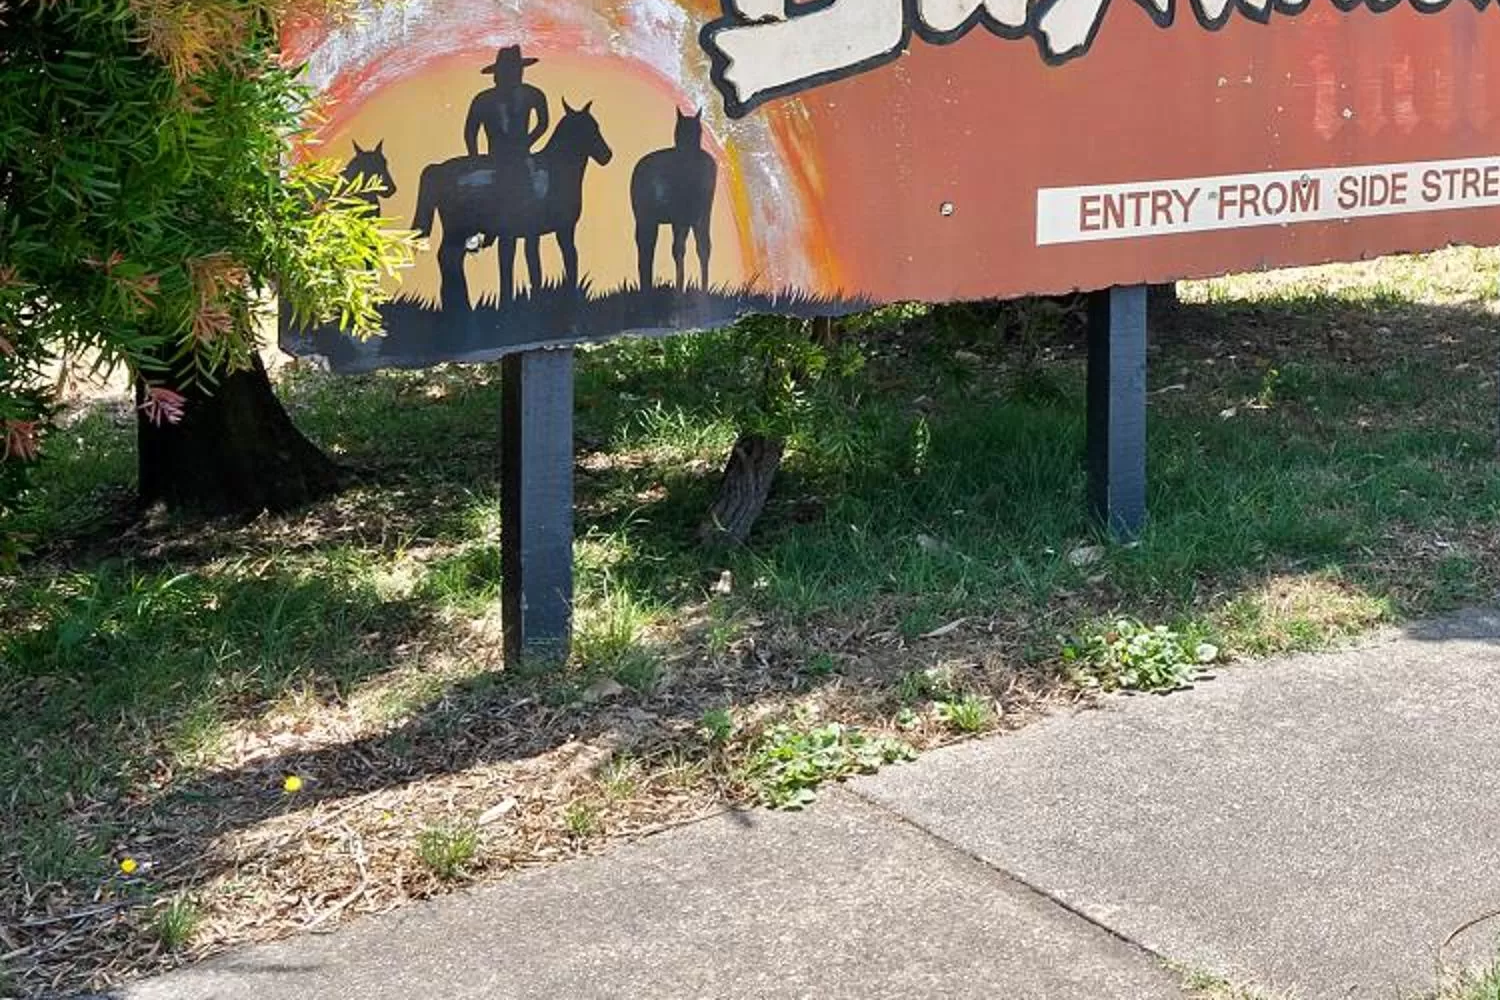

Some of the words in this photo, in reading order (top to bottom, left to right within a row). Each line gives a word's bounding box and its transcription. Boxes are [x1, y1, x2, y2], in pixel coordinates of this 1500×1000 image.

[1079, 187, 1200, 233] ENTRY
[1217, 178, 1321, 221] FROM
[1336, 172, 1408, 210] SIDE
